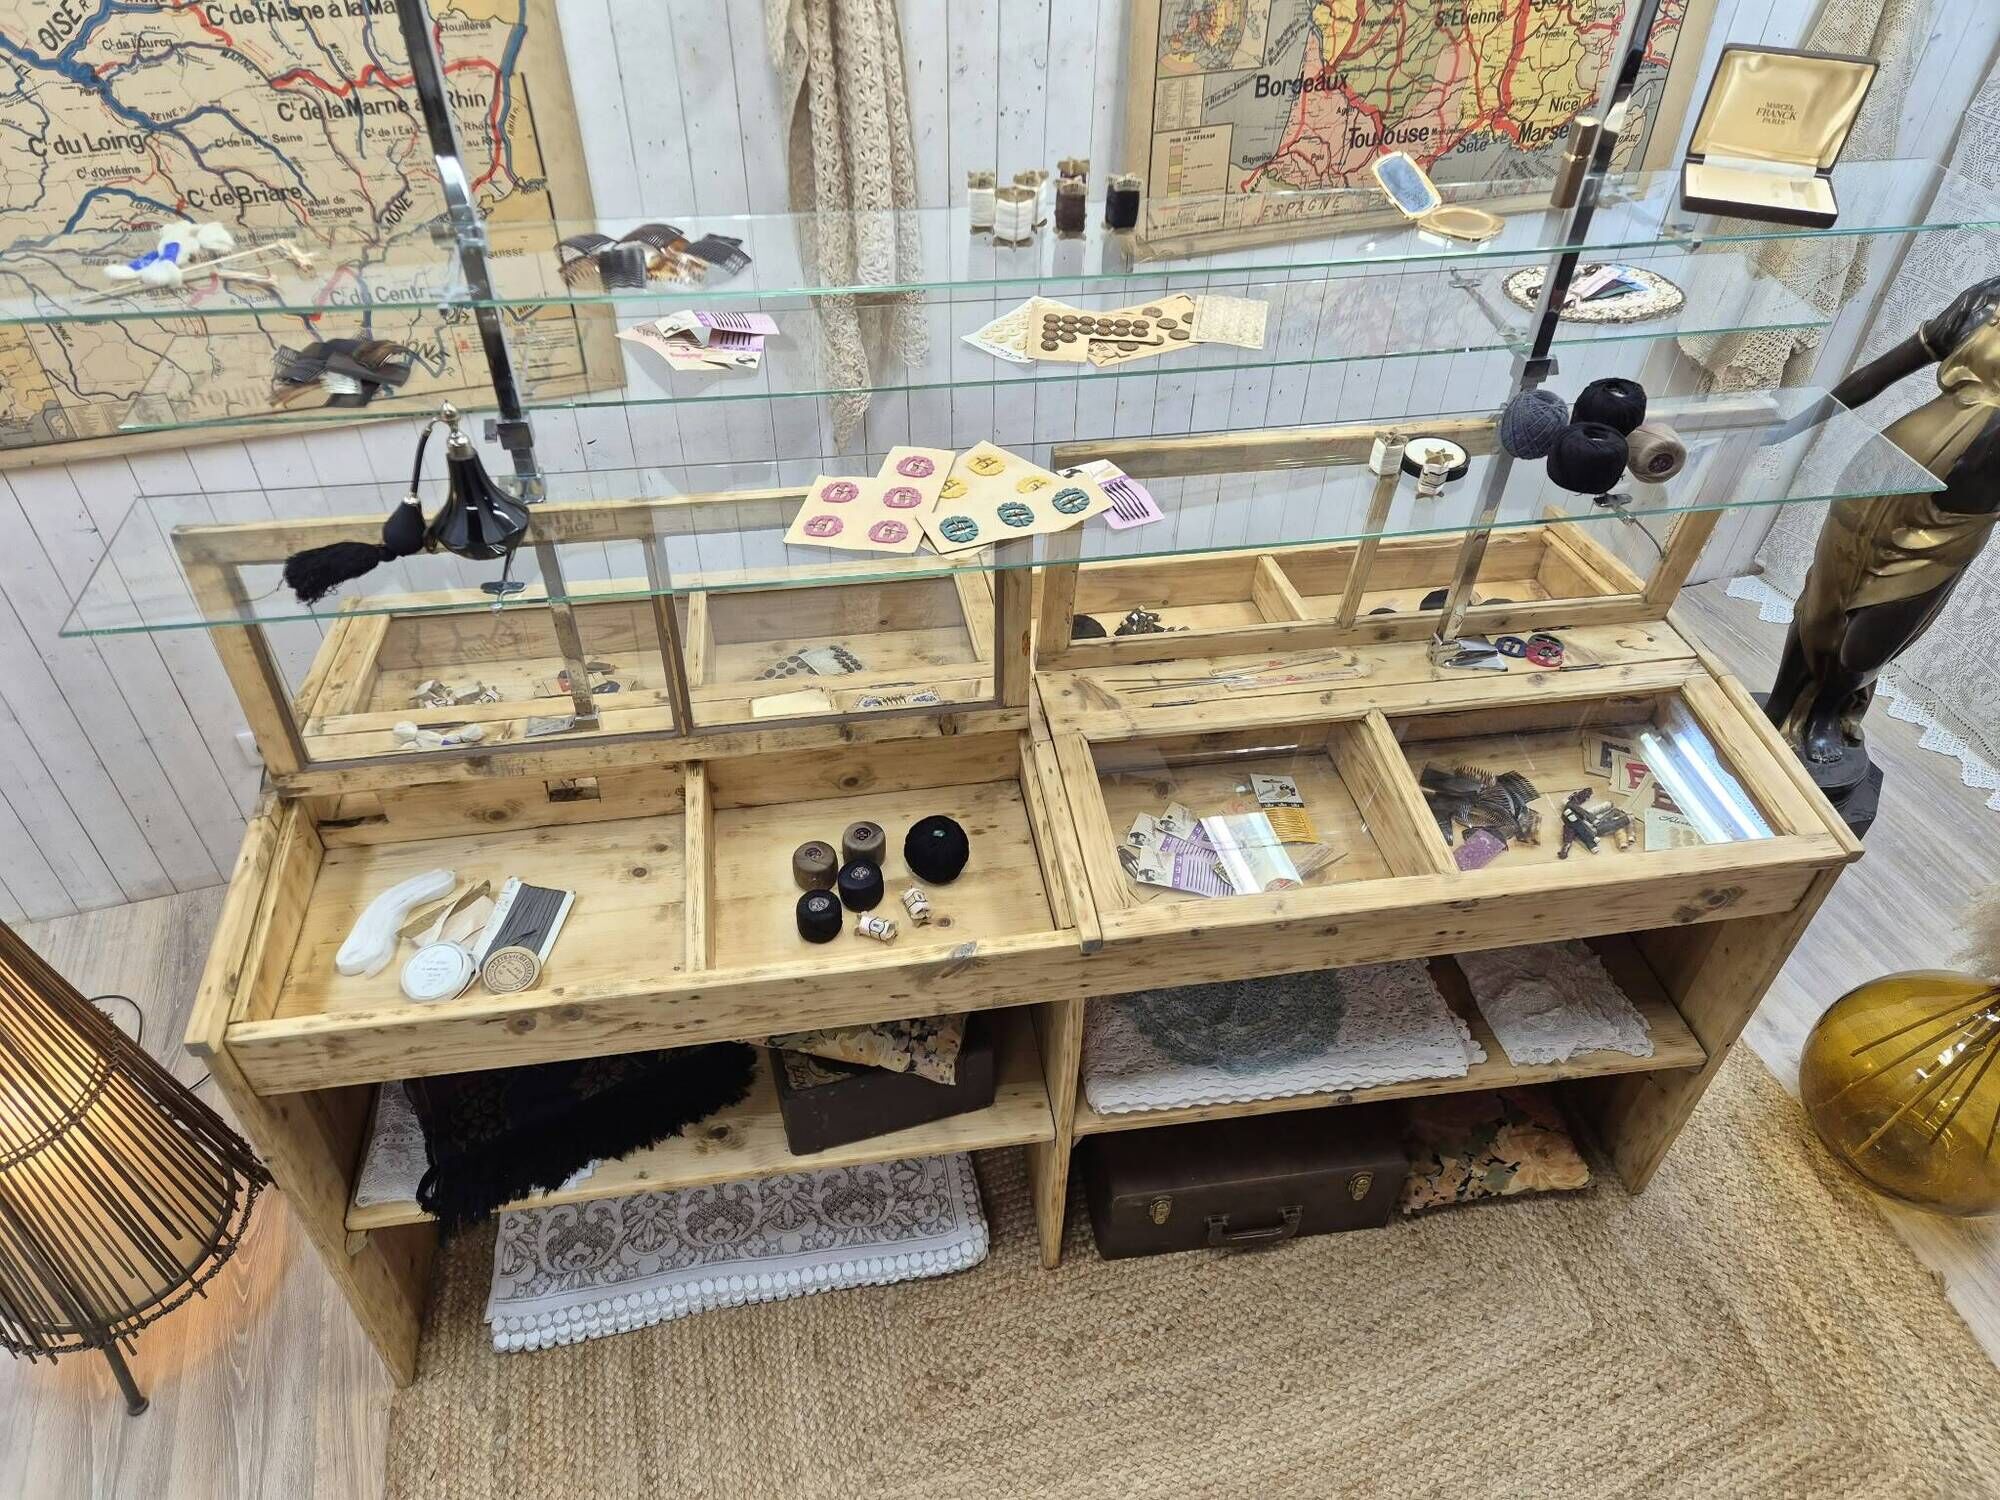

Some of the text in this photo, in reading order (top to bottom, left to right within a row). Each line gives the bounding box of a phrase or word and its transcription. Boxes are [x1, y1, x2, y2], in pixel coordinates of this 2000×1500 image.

[230, 7, 254, 25] de
[345, 0, 363, 16] la
[366, 0, 397, 14] Ma
[38, 0, 82, 51] OISE
[116, 40, 129, 49] de
[1255, 71, 1348, 99] Bordeaux
[300, 101, 322, 120] de
[327, 99, 346, 118] la
[346, 98, 410, 117] Marne
[1549, 97, 1578, 113] Nice
[1756, 107, 1797, 120] FRANCK
[54, 134, 82, 155] du
[83, 130, 146, 154] Loing
[272, 134, 303, 144] Seine
[1349, 126, 1429, 148] Toulouse
[1520, 122, 1569, 143] Marse
[1618, 134, 1640, 142] ORSE
[92, 166, 141, 178] d'Orléans
[210, 187, 233, 206] de
[237, 184, 302, 204] Briare
[308, 206, 363, 217] Bourgogne
[1263, 196, 1343, 217] ESPAGNE
[375, 286, 425, 303] Centr
